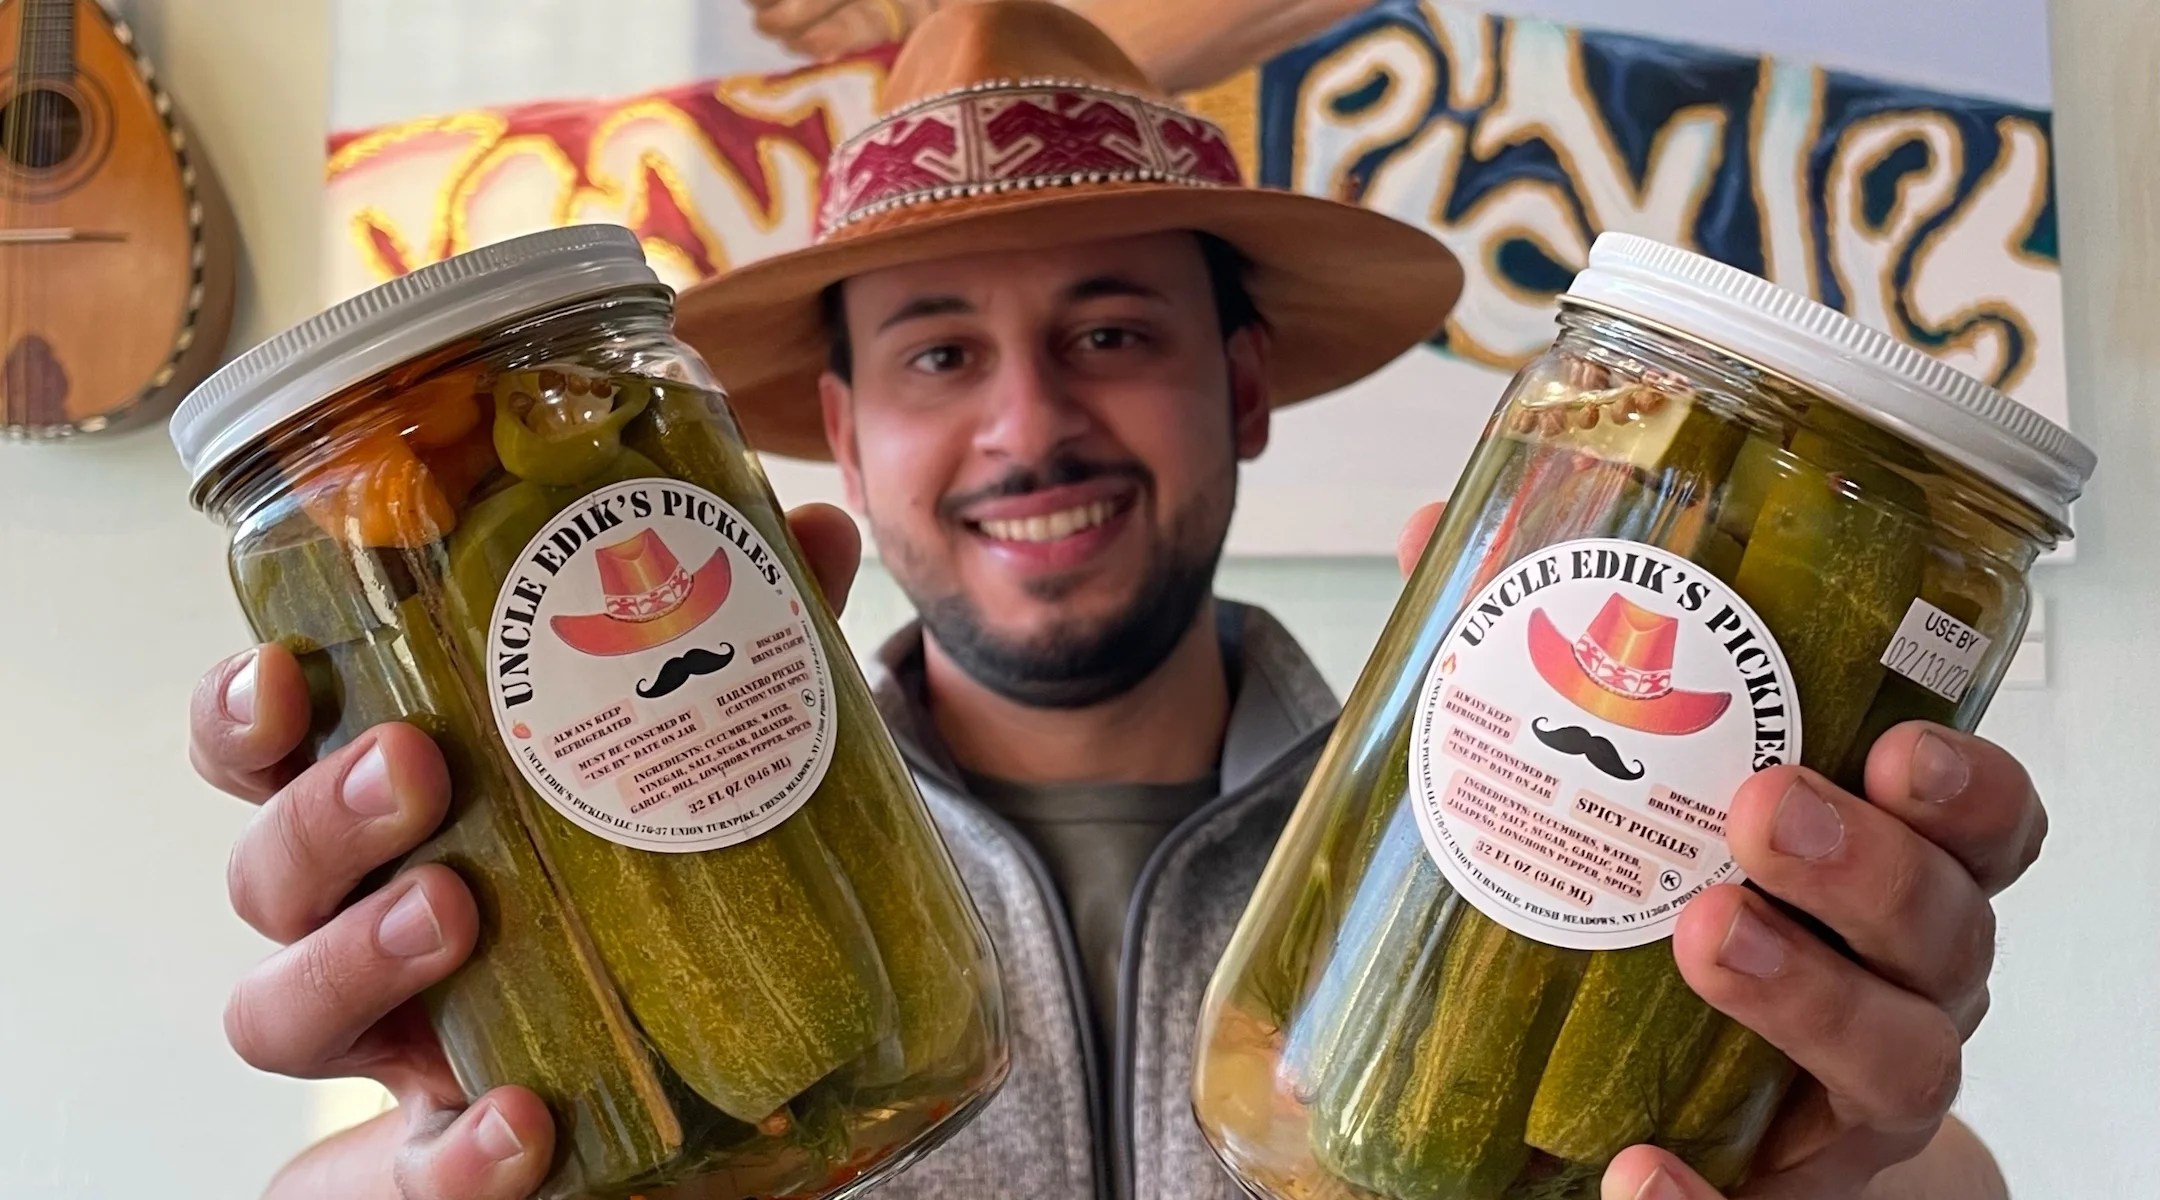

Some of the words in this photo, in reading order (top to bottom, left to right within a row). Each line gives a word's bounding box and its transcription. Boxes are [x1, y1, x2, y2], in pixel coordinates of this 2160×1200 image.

[499, 576, 547, 709] UNCLE
[661, 490, 782, 586] PICKLES
[1459, 556, 1561, 646] UNCLE
[1925, 612, 1961, 643] USE
[1956, 630, 1980, 653] BY
[716, 675, 772, 707] HABANERO
[771, 660, 806, 682] PICKLES
[766, 682, 787, 696] VERY
[1429, 678, 1443, 708] UNCLE
[553, 720, 593, 745] ALWAYS
[594, 706, 622, 725] KEEP
[1445, 701, 1511, 739] REFRIGERATED
[1455, 690, 1487, 712] ALWAYS
[1487, 707, 1513, 723] KEEP
[554, 716, 632, 758] REFRIGERATED
[578, 750, 607, 771] MUST
[608, 743, 624, 757] BE
[624, 718, 678, 750] CONSUMED
[678, 710, 693, 723] BY
[634, 740, 662, 759] DATE
[661, 733, 676, 745] ON
[677, 723, 697, 738] JAR
[634, 746, 704, 783] INGREDIENTS:
[639, 768, 688, 795] VINEGAR,
[688, 754, 716, 771] SALT,
[1422, 747, 1433, 789] PICKLES
[1452, 728, 1478, 745] MUST
[1477, 740, 1490, 752] BE
[1490, 746, 1543, 780] CONSUMED
[1543, 774, 1560, 787] BY
[523, 746, 547, 776] UNCLE
[572, 797, 613, 824] PICKLES
[614, 818, 633, 831] LLC
[671, 826, 704, 837] UNION
[706, 809, 760, 834] TURNPIKE,
[760, 791, 787, 813] FRESH
[630, 791, 672, 814] GARLIC,
[672, 778, 699, 794] DILL,
[688, 799, 706, 814] 32
[707, 789, 725, 806] FL
[744, 766, 770, 789] (946
[770, 756, 792, 773] ML)
[1489, 762, 1514, 779] DATE
[1515, 775, 1529, 788] ON
[1530, 783, 1552, 799] JAR
[1464, 776, 1531, 816] INGREDIENTS:
[1533, 811, 1599, 850] CUCUMBERS,
[1603, 844, 1642, 870] WATER,
[1648, 797, 1684, 819] BRINE
[1684, 813, 1697, 823] IS
[1669, 791, 1716, 817] DISCARD
[1456, 787, 1499, 817] VINEGAR,
[1501, 811, 1529, 832] SALT,
[1532, 825, 1569, 851] SUGAR,
[1572, 846, 1613, 872] GARLIC,
[1616, 865, 1642, 885] DILL,
[1575, 797, 1627, 827] SPICY
[1628, 820, 1699, 860] PICKLES
[1449, 840, 1475, 870] UNION
[1476, 840, 1493, 855] 32
[1494, 850, 1511, 866] FL
[1514, 859, 1532, 876] OZ
[1534, 868, 1565, 892] (946
[1567, 884, 1593, 906] ML)
[1499, 825, 1554, 858] LONGHORN
[1557, 853, 1602, 881] PEPPER,
[1605, 875, 1642, 898] SPICES
[1472, 867, 1522, 907] TURNPIKE,
[1671, 883, 1704, 908] PHONE
[1524, 902, 1559, 920] FRESH
[1562, 913, 1620, 925] MEADOWS,
[1622, 912, 1638, 923] NY
